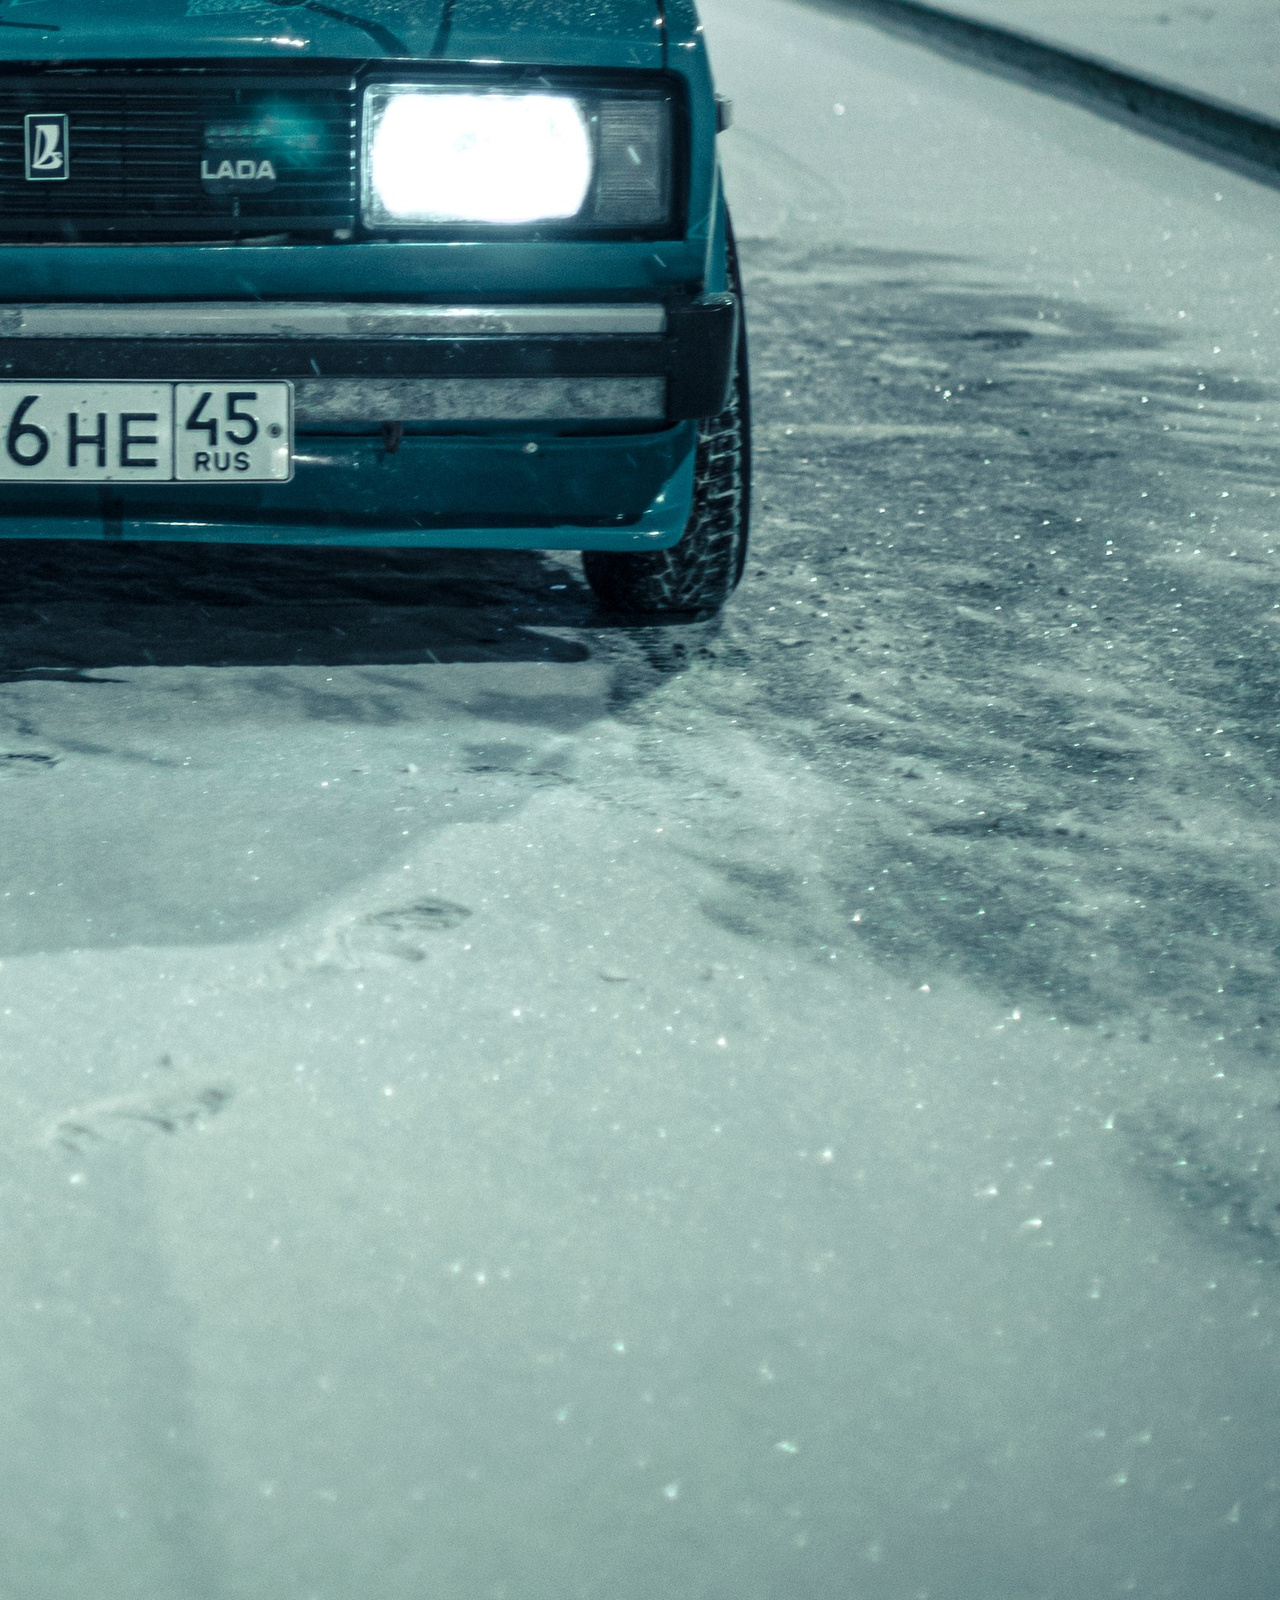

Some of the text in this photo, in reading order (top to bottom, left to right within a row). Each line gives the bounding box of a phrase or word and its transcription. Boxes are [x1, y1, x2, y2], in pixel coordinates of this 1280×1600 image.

[200, 159, 277, 180] LADA
[185, 391, 259, 446] 45
[194, 451, 250, 472] RUS
